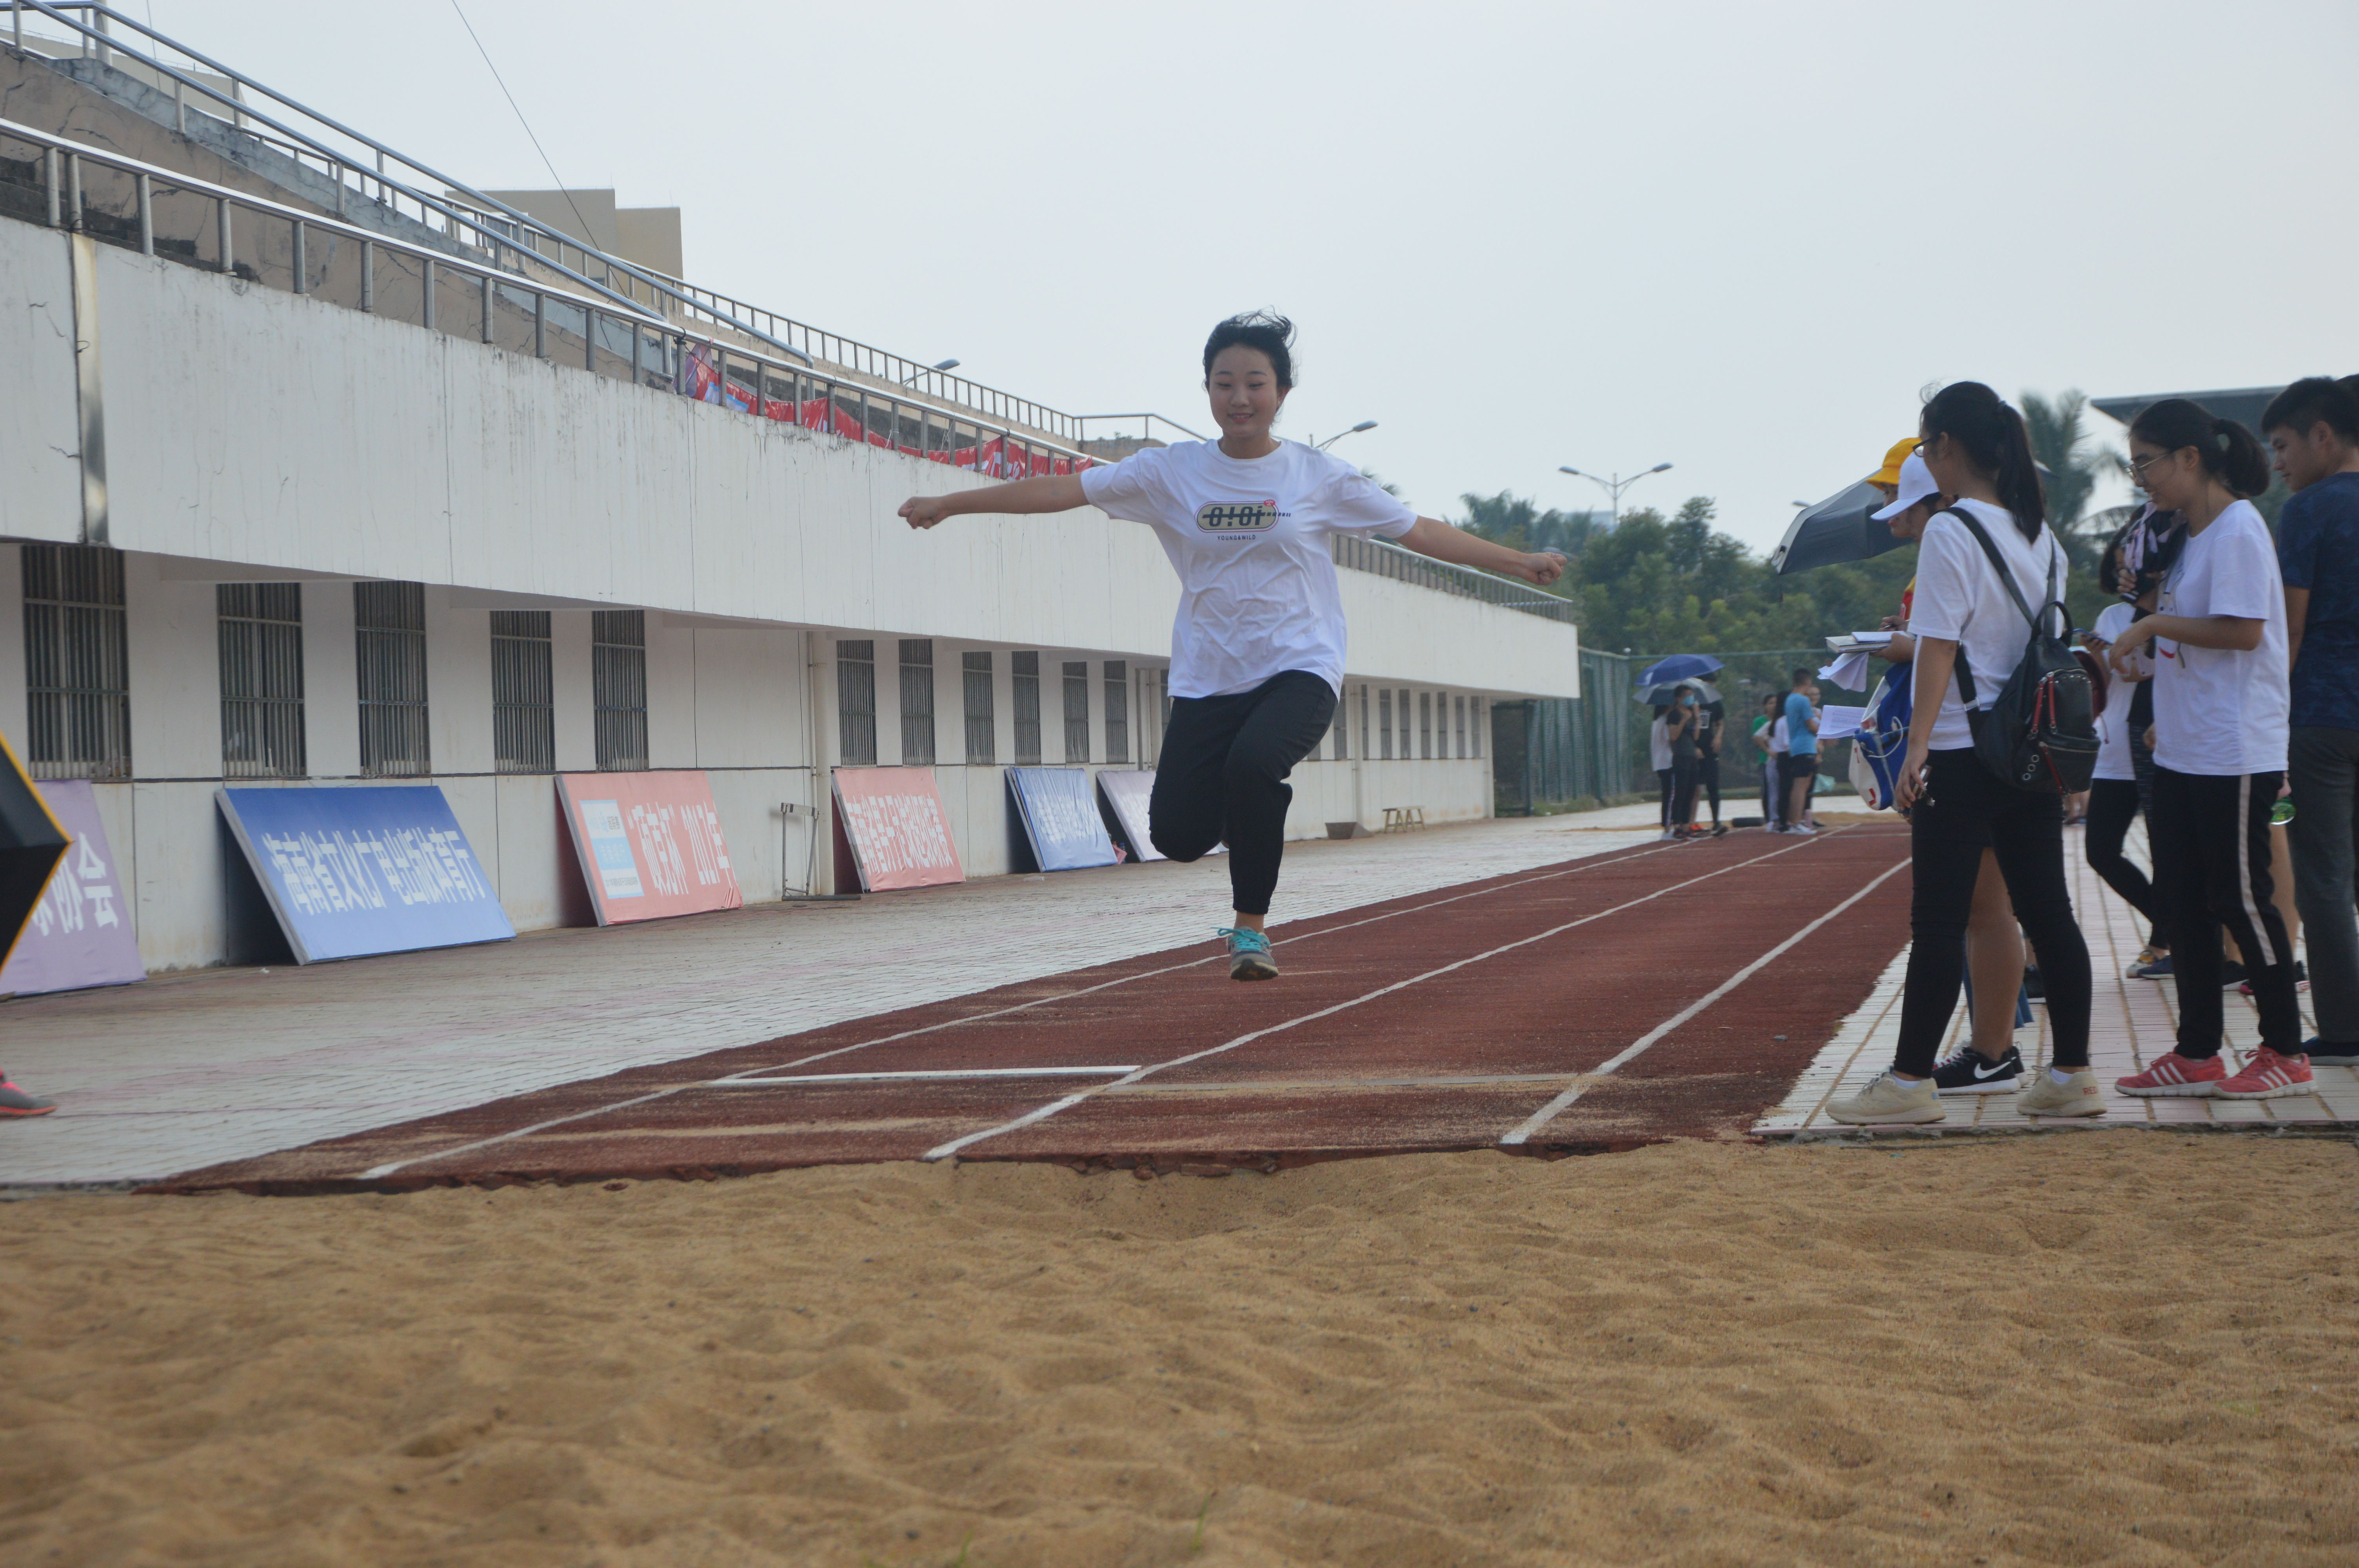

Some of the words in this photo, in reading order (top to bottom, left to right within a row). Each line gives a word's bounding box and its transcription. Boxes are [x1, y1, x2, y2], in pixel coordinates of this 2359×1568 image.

[31, 831, 119, 936] 协会
[261, 826, 486, 916] 海南省文化广电出版体育厅
